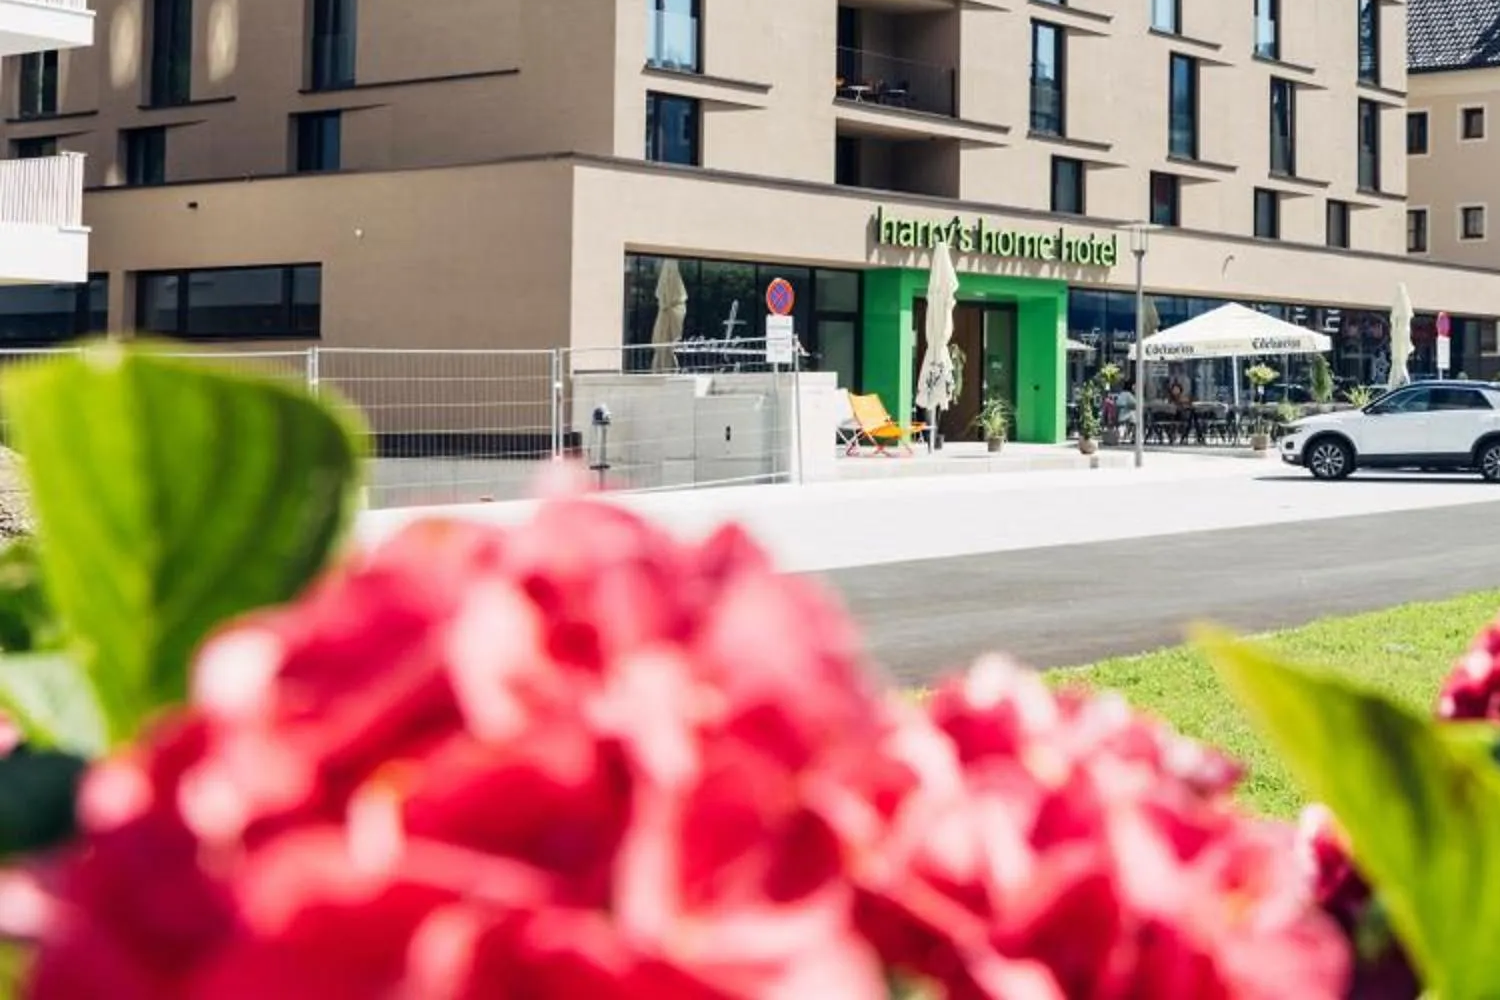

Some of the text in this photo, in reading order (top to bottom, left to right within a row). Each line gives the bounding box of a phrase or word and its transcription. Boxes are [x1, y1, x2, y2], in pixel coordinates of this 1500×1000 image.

[878, 205, 1117, 267] harry's home hotel
